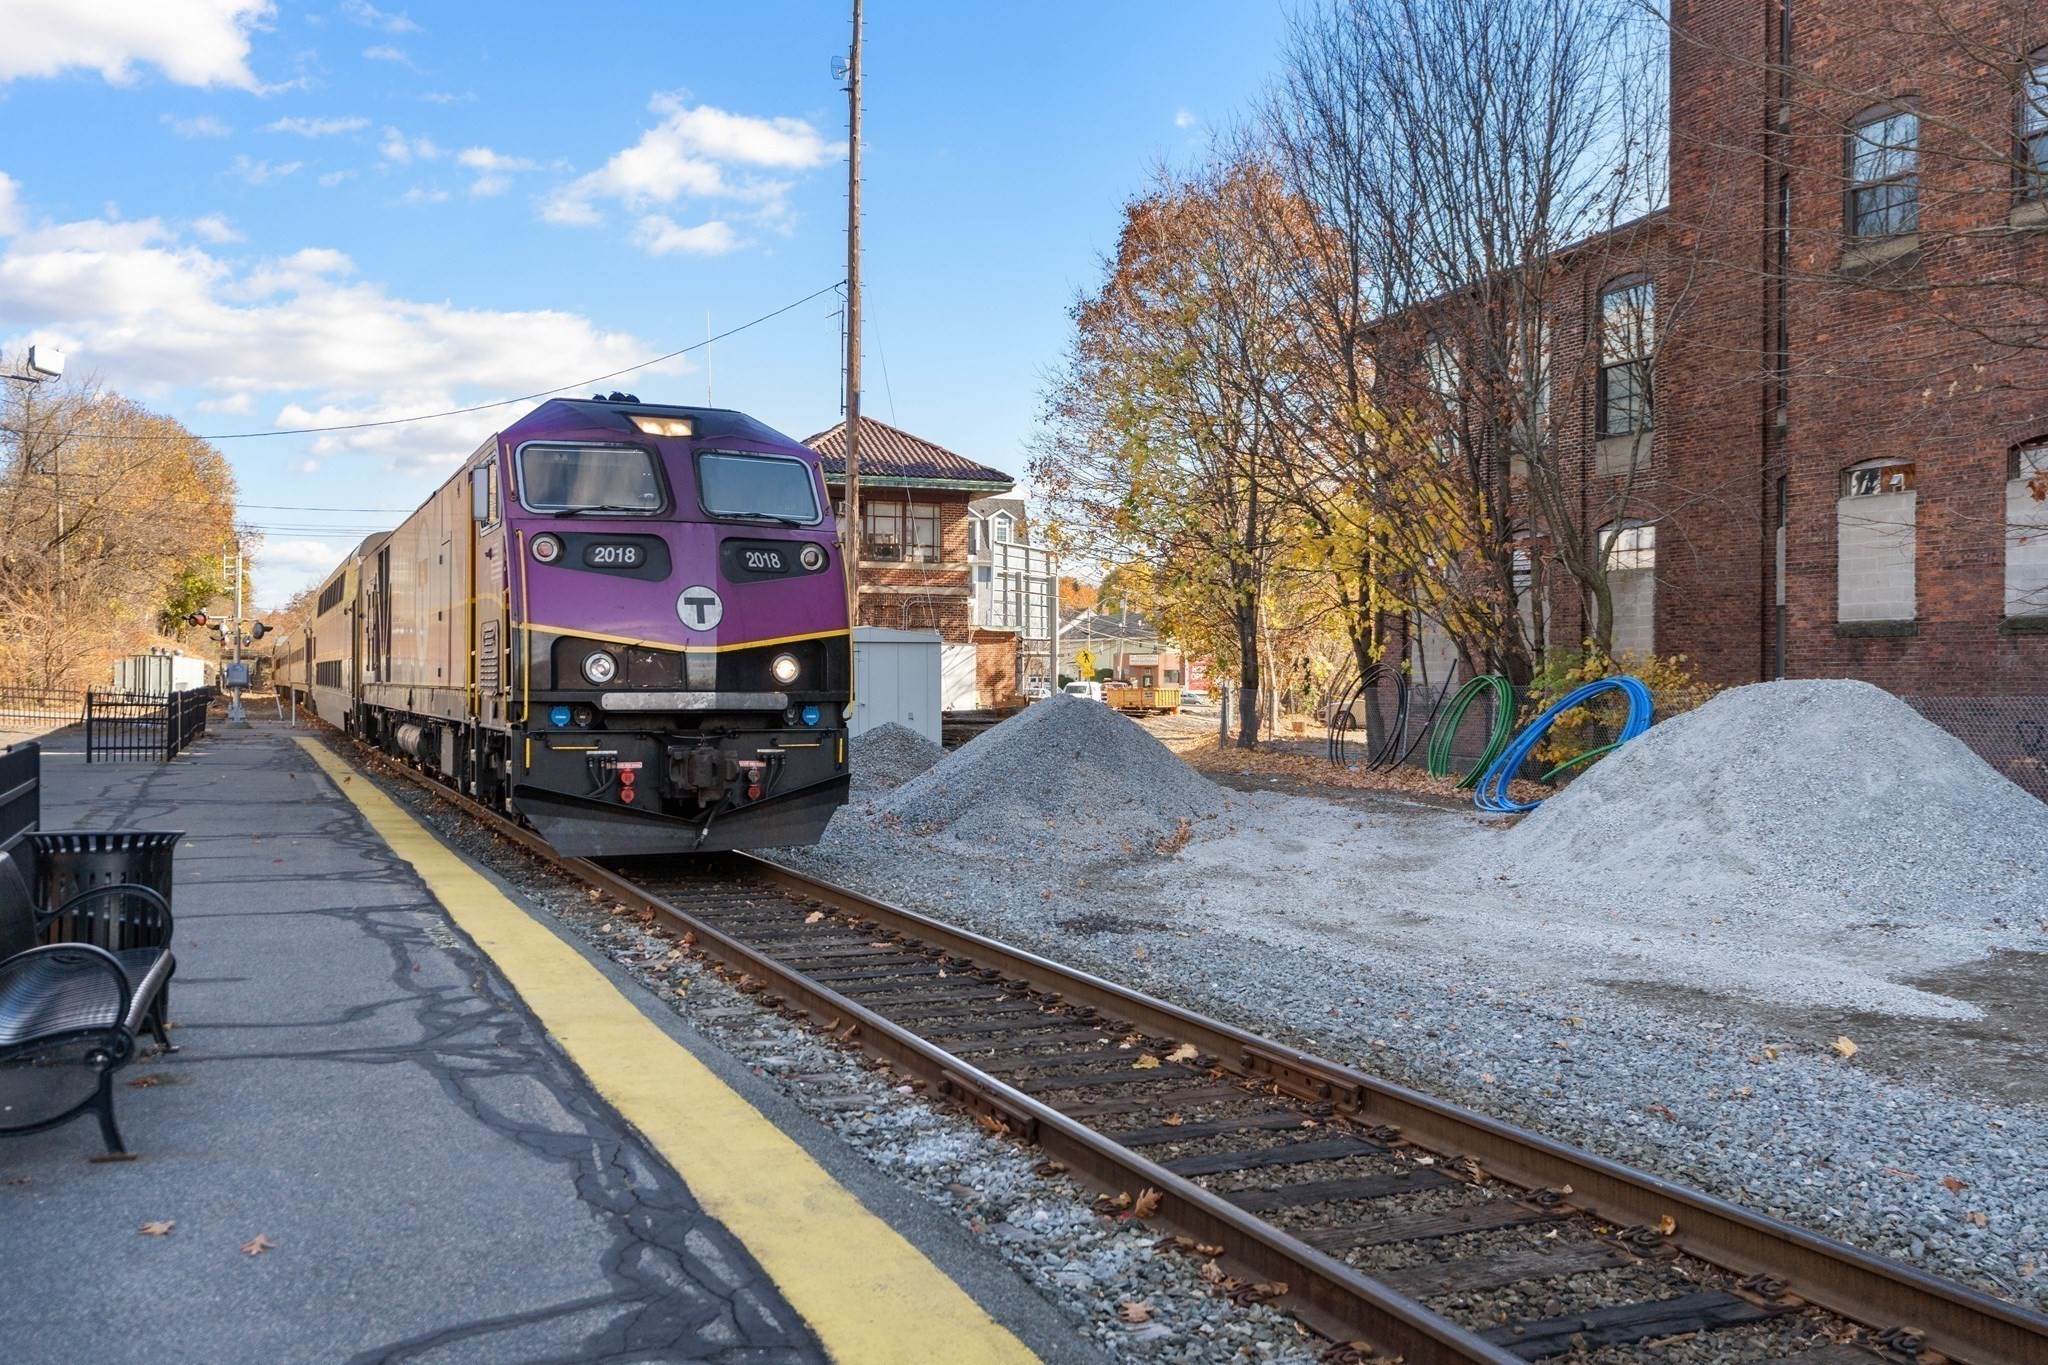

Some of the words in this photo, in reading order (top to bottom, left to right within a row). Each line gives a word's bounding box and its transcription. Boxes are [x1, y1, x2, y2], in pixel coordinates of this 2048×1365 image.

[594, 547, 636, 563] 2018
[746, 551, 781, 569] 2018
[684, 597, 715, 624] T
